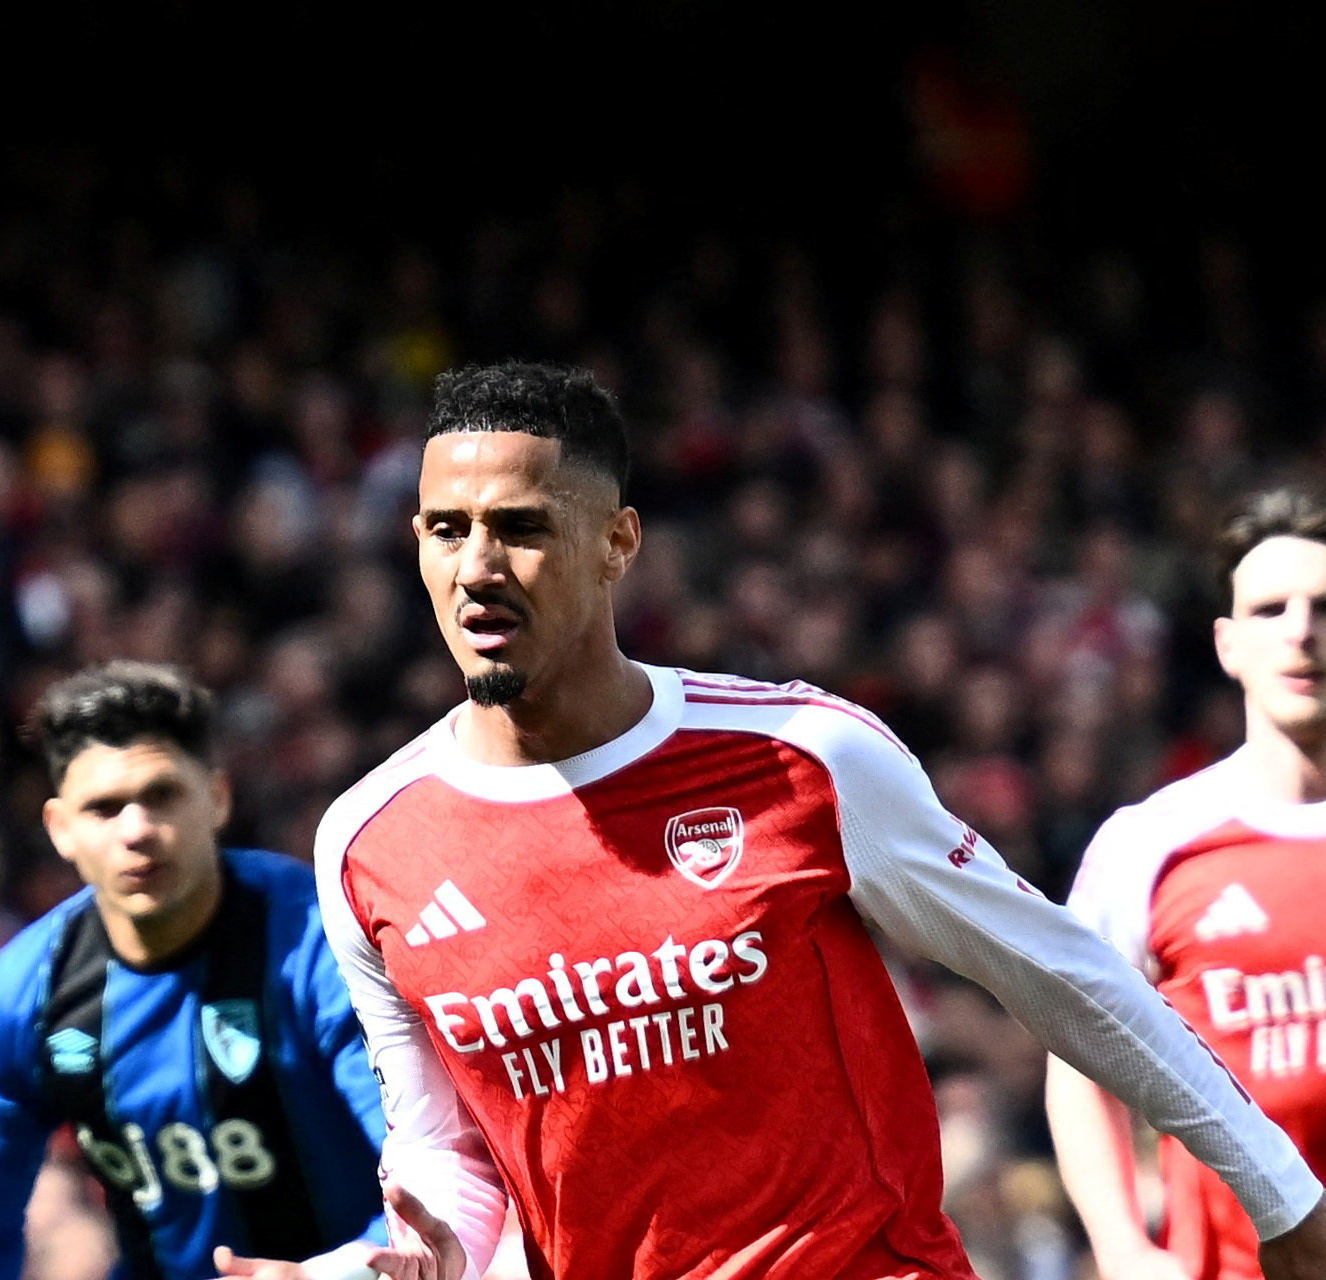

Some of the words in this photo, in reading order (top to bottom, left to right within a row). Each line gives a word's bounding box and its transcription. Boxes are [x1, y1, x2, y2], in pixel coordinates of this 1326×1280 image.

[676, 816, 732, 838] Arsenal
[423, 930, 770, 1054] Emirates
[502, 1038, 566, 1101] FLY
[580, 1002, 730, 1084] BETTER
[1249, 1020, 1308, 1081] FLY
[76, 1117, 276, 1213] bj88
